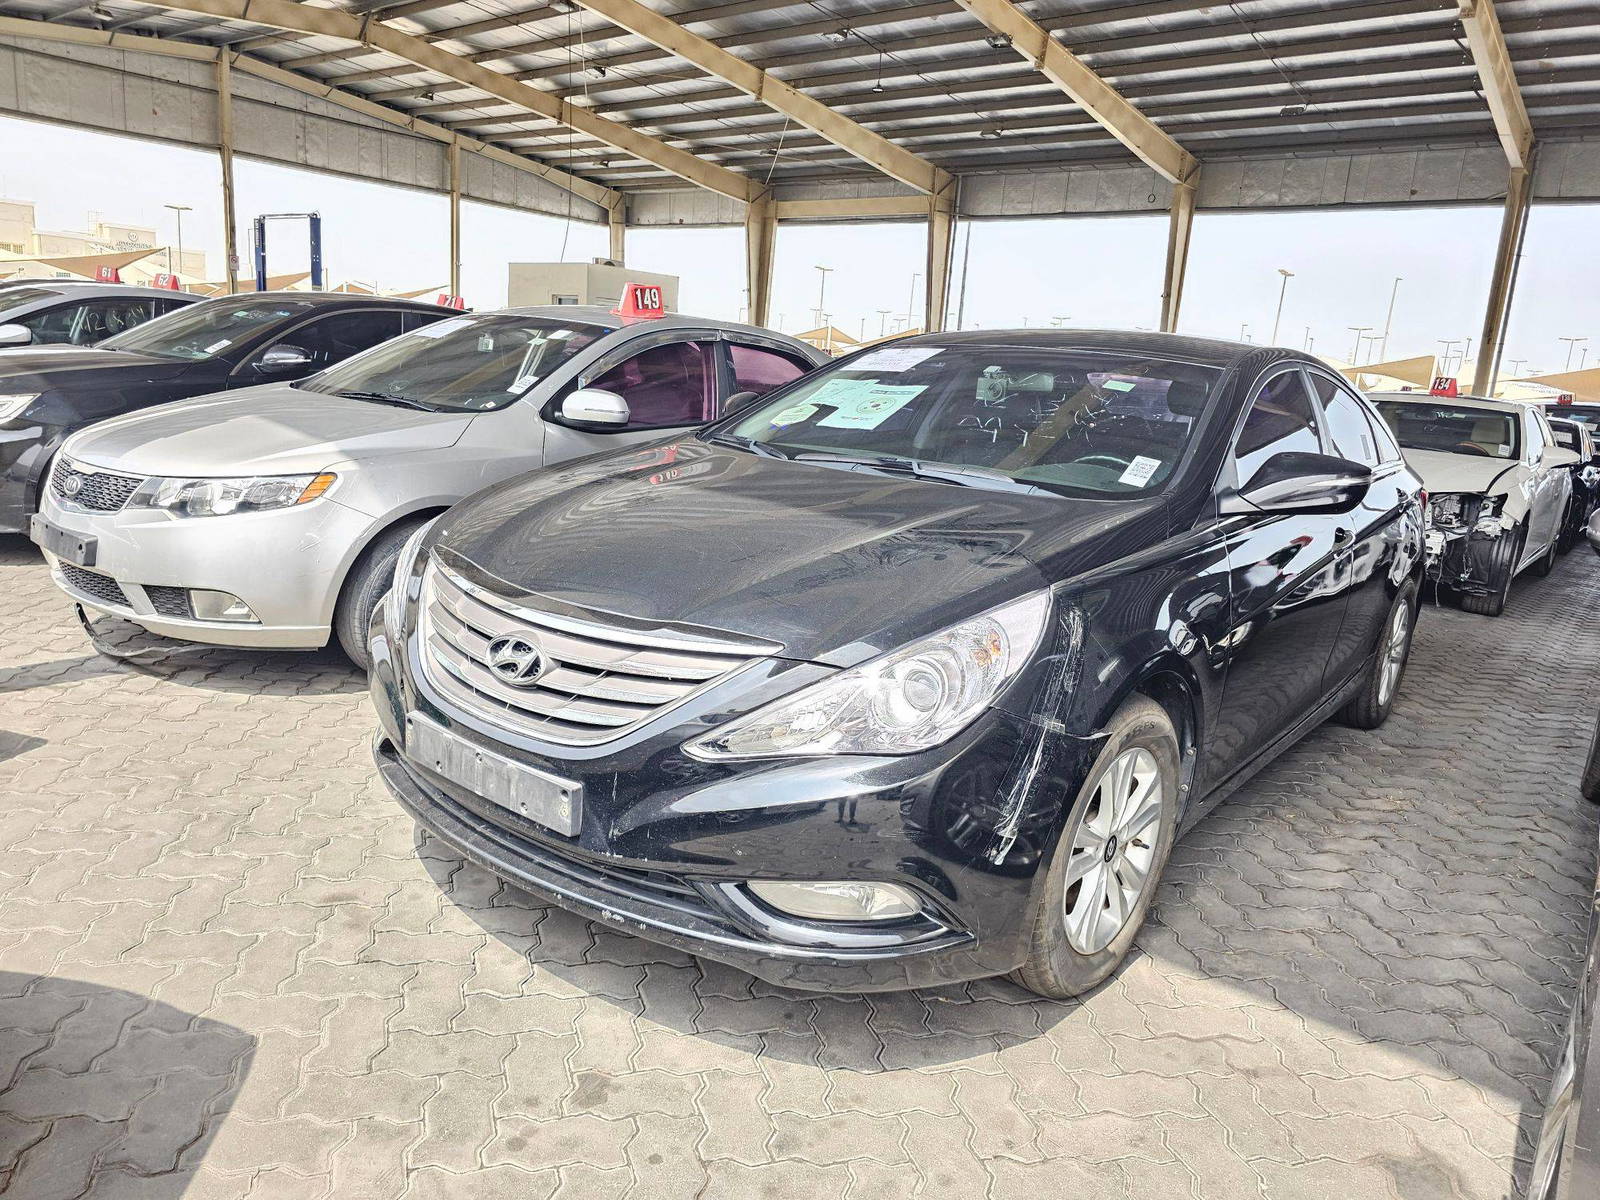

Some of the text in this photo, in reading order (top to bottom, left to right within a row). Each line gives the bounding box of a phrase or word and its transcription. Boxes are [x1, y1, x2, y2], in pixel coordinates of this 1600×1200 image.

[101, 267, 112, 278] 61
[158, 274, 169, 286] 62
[635, 288, 660, 310] 149
[1433, 377, 1451, 390] 134
